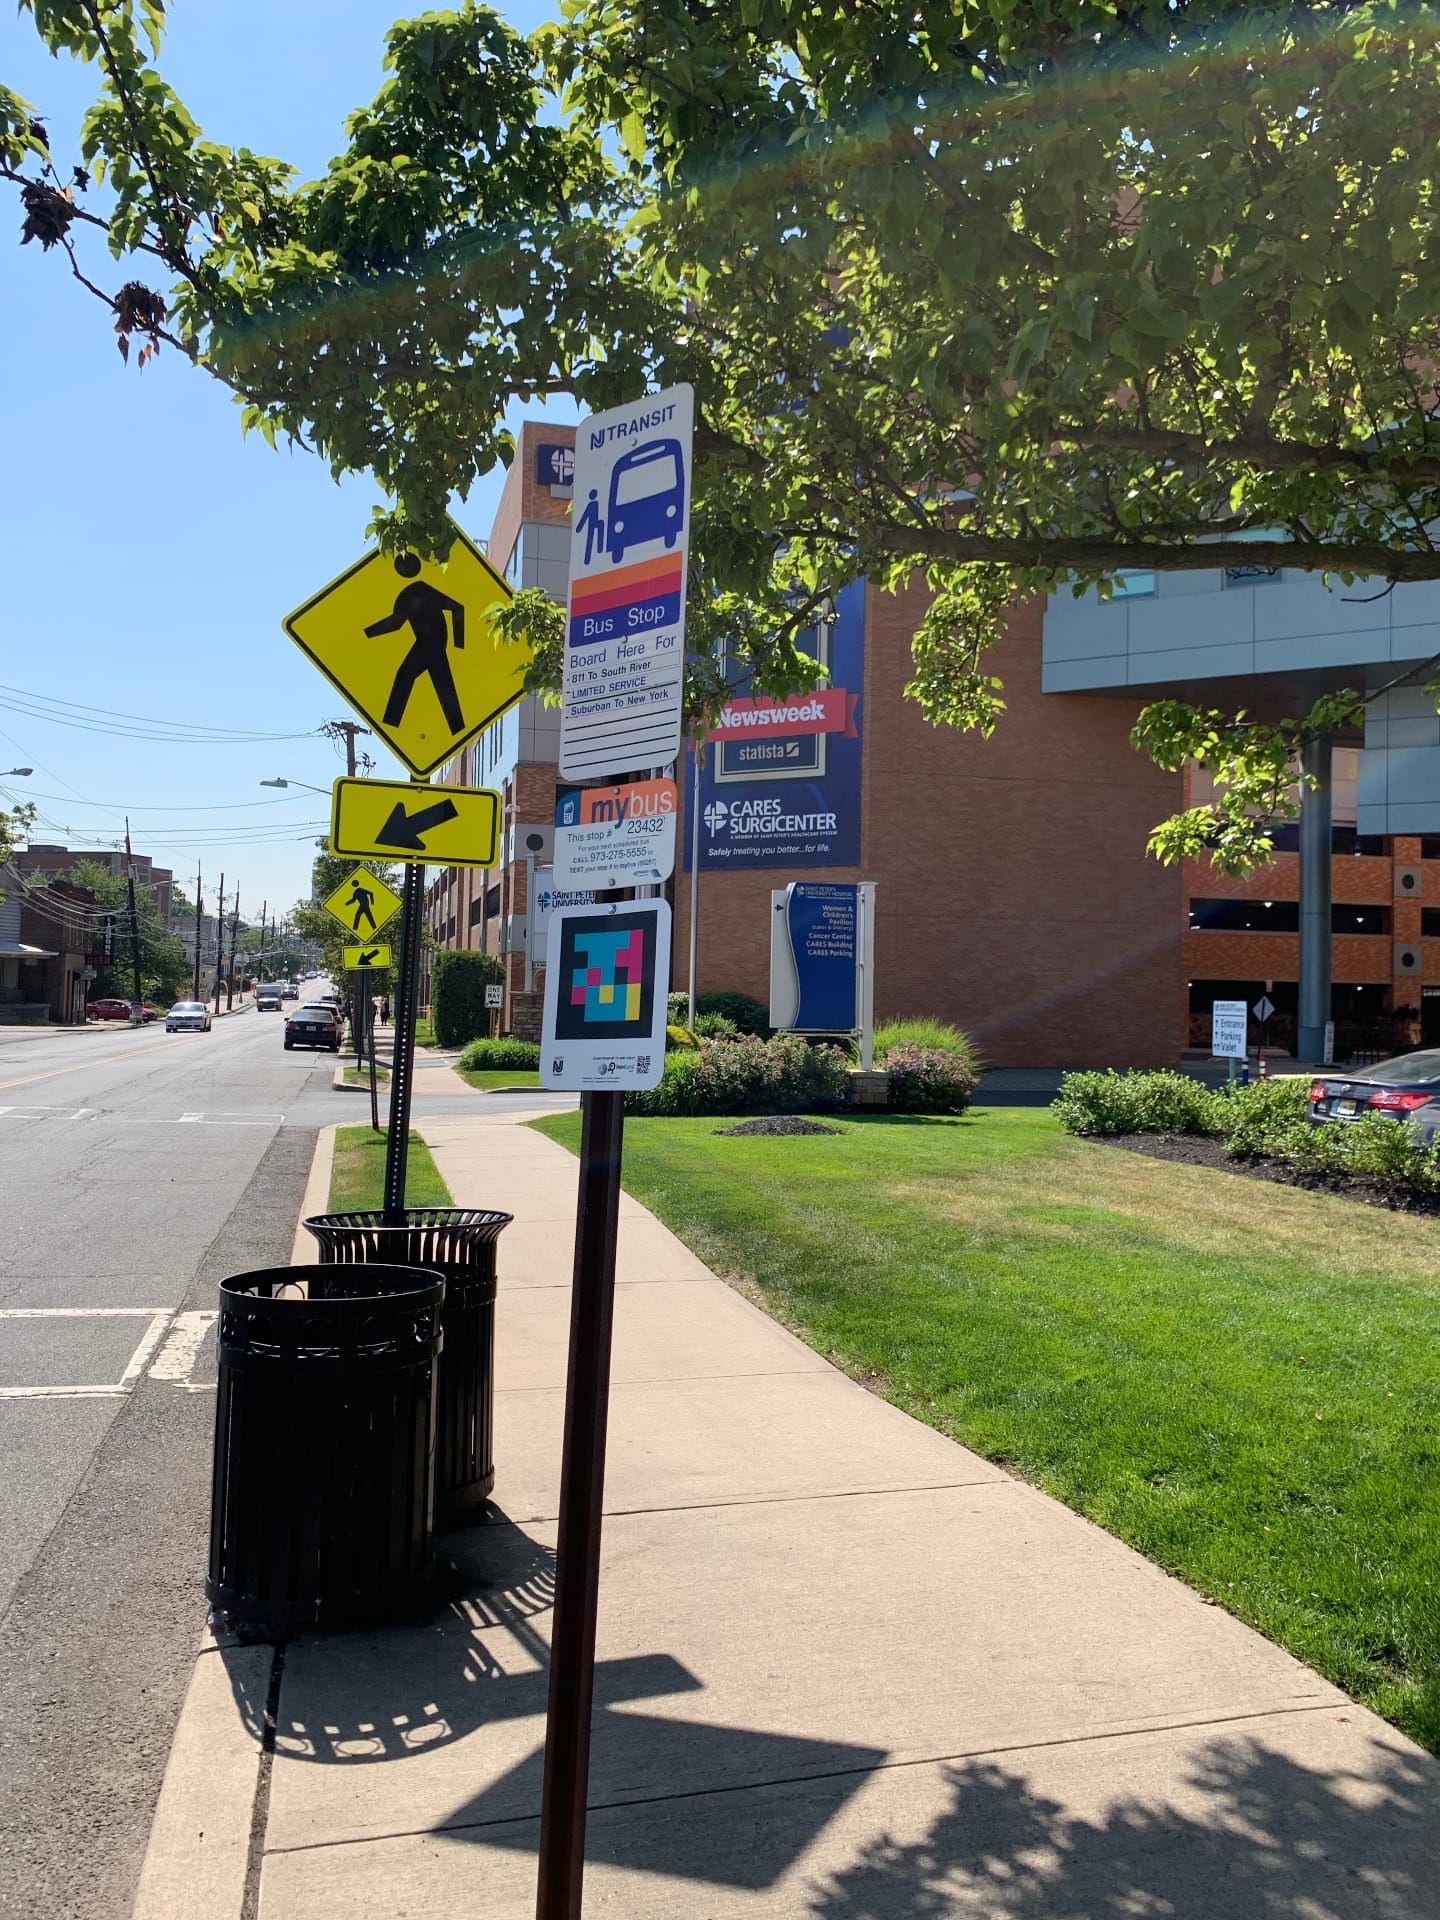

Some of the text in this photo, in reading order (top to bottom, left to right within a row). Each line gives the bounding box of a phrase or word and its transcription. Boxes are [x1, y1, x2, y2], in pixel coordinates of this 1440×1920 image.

[584, 605, 665, 637] Bus Stop
[570, 634, 676, 669] Board Here For
[572, 661, 651, 684] 811 To South River
[572, 676, 646, 699] LIMITED SERVICE
[571, 689, 668, 716] Suburban To New York
[716, 700, 826, 728] Newsweek
[739, 743, 784, 761] statista
[591, 789, 672, 830] mybus
[730, 799, 782, 817] CARES
[568, 818, 664, 842] This stop # 23432
[730, 813, 837, 834] SURGICENTER
[590, 847, 646, 862] 973-275-5555
[708, 846, 732, 858] Safely
[733, 846, 760, 856] treating
[762, 846, 776, 856] you
[552, 891, 573, 900] SAINT
[828, 941, 853, 950] Building
[830, 950, 853, 958] Parking
[1220, 1018, 1244, 1029] Entrance
[1220, 1032, 1241, 1044] Parking
